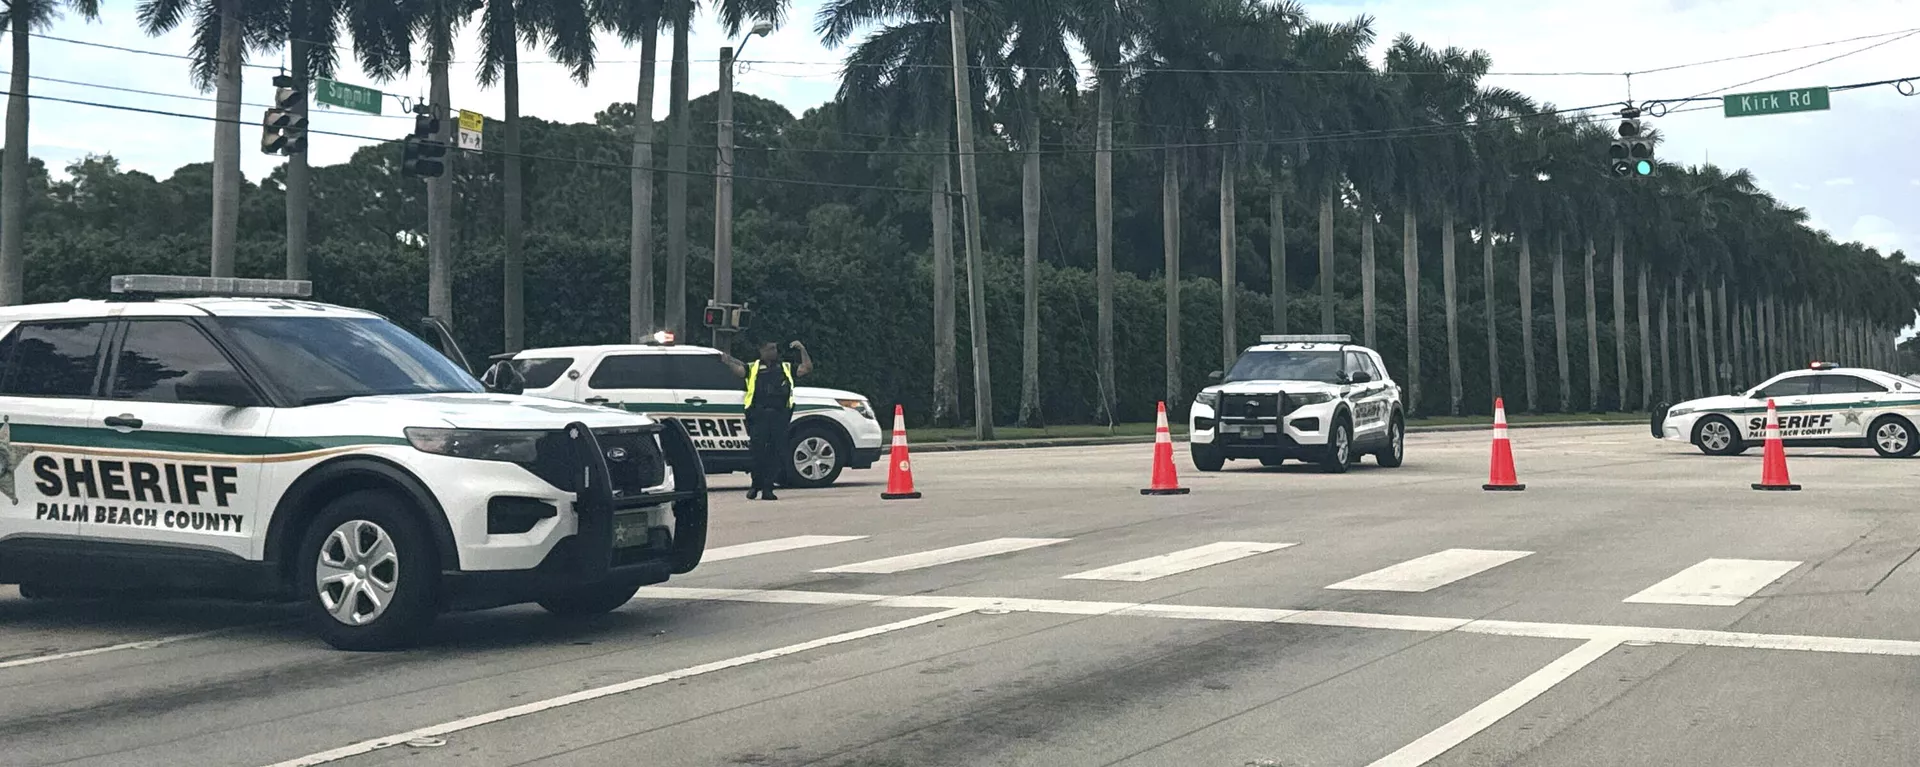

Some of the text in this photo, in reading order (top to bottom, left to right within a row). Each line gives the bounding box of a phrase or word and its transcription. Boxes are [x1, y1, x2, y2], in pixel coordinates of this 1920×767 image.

[329, 81, 371, 105] Summit
[1741, 91, 1811, 112] Kirk Rd
[681, 418, 749, 437] ERIF
[1801, 427, 1833, 435] COUNTY
[693, 439, 749, 449] ACH COUN
[33, 455, 238, 507] SHERIFF
[36, 502, 244, 533] PALM BEACH COUNTY
